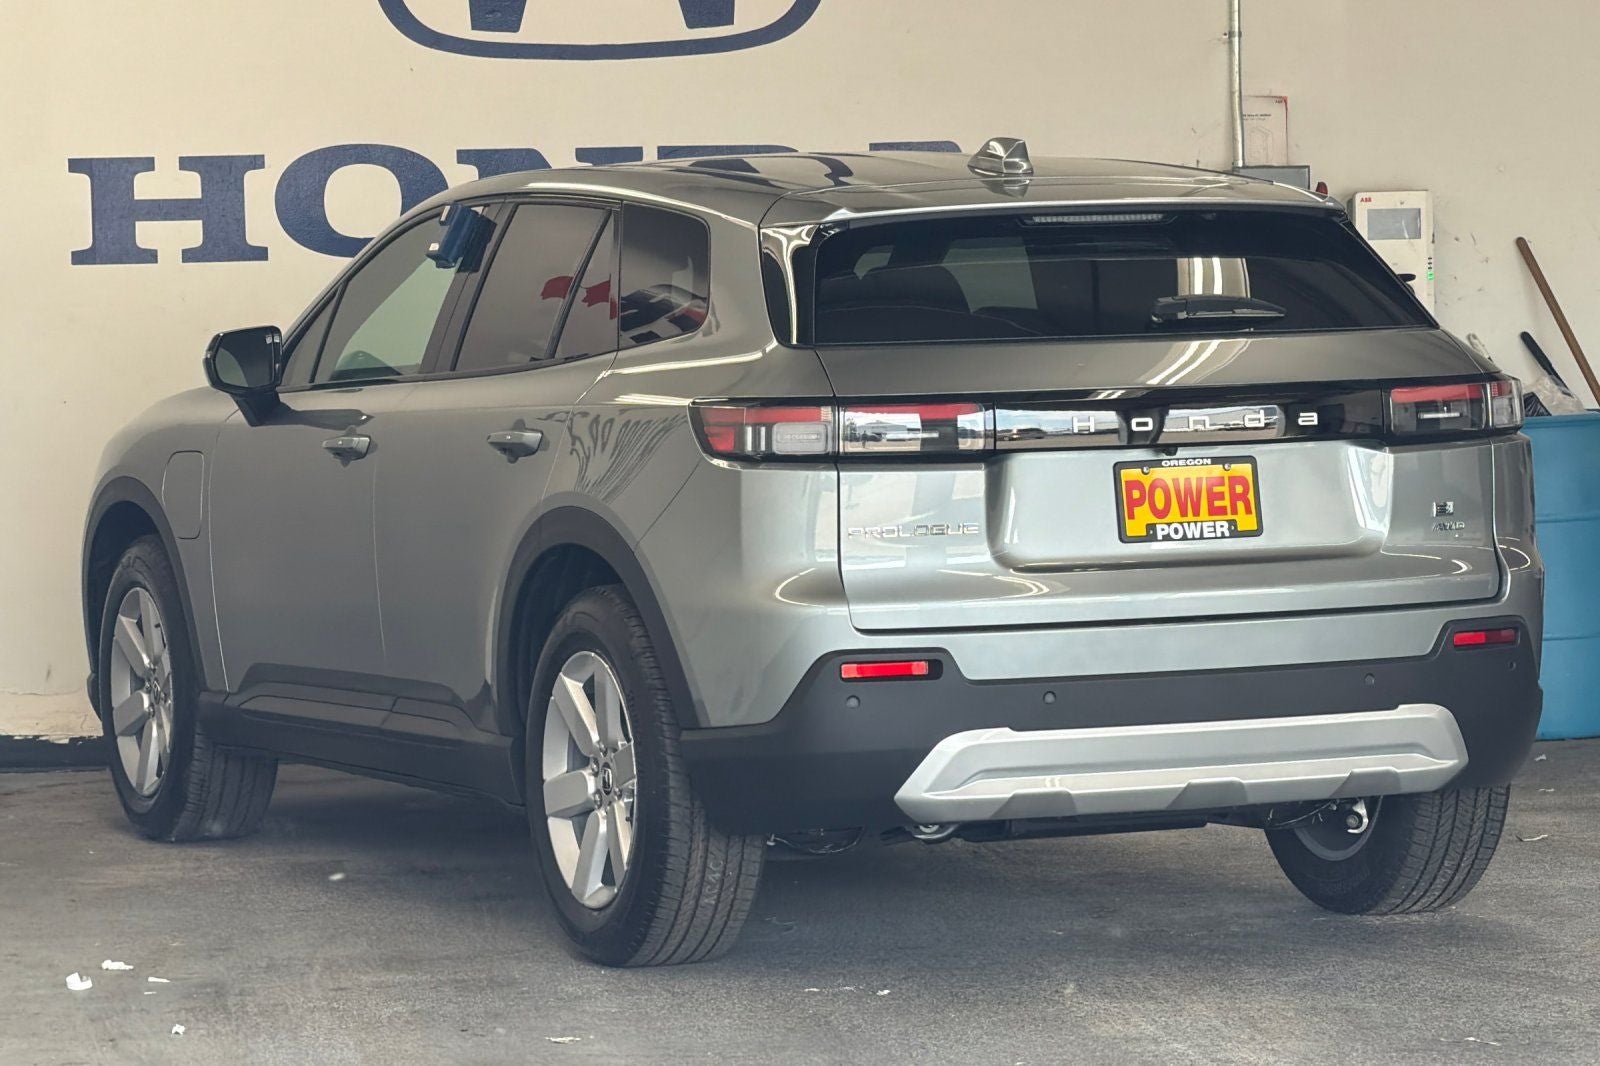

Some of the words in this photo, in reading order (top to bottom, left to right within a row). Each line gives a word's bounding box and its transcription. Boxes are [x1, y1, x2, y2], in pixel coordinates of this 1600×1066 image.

[1072, 409, 1319, 434] Honda
[1161, 458, 1212, 467] OREGON
[1124, 475, 1253, 521] POWER
[847, 522, 980, 539] PROLOGUE
[1155, 520, 1230, 540] POWER
